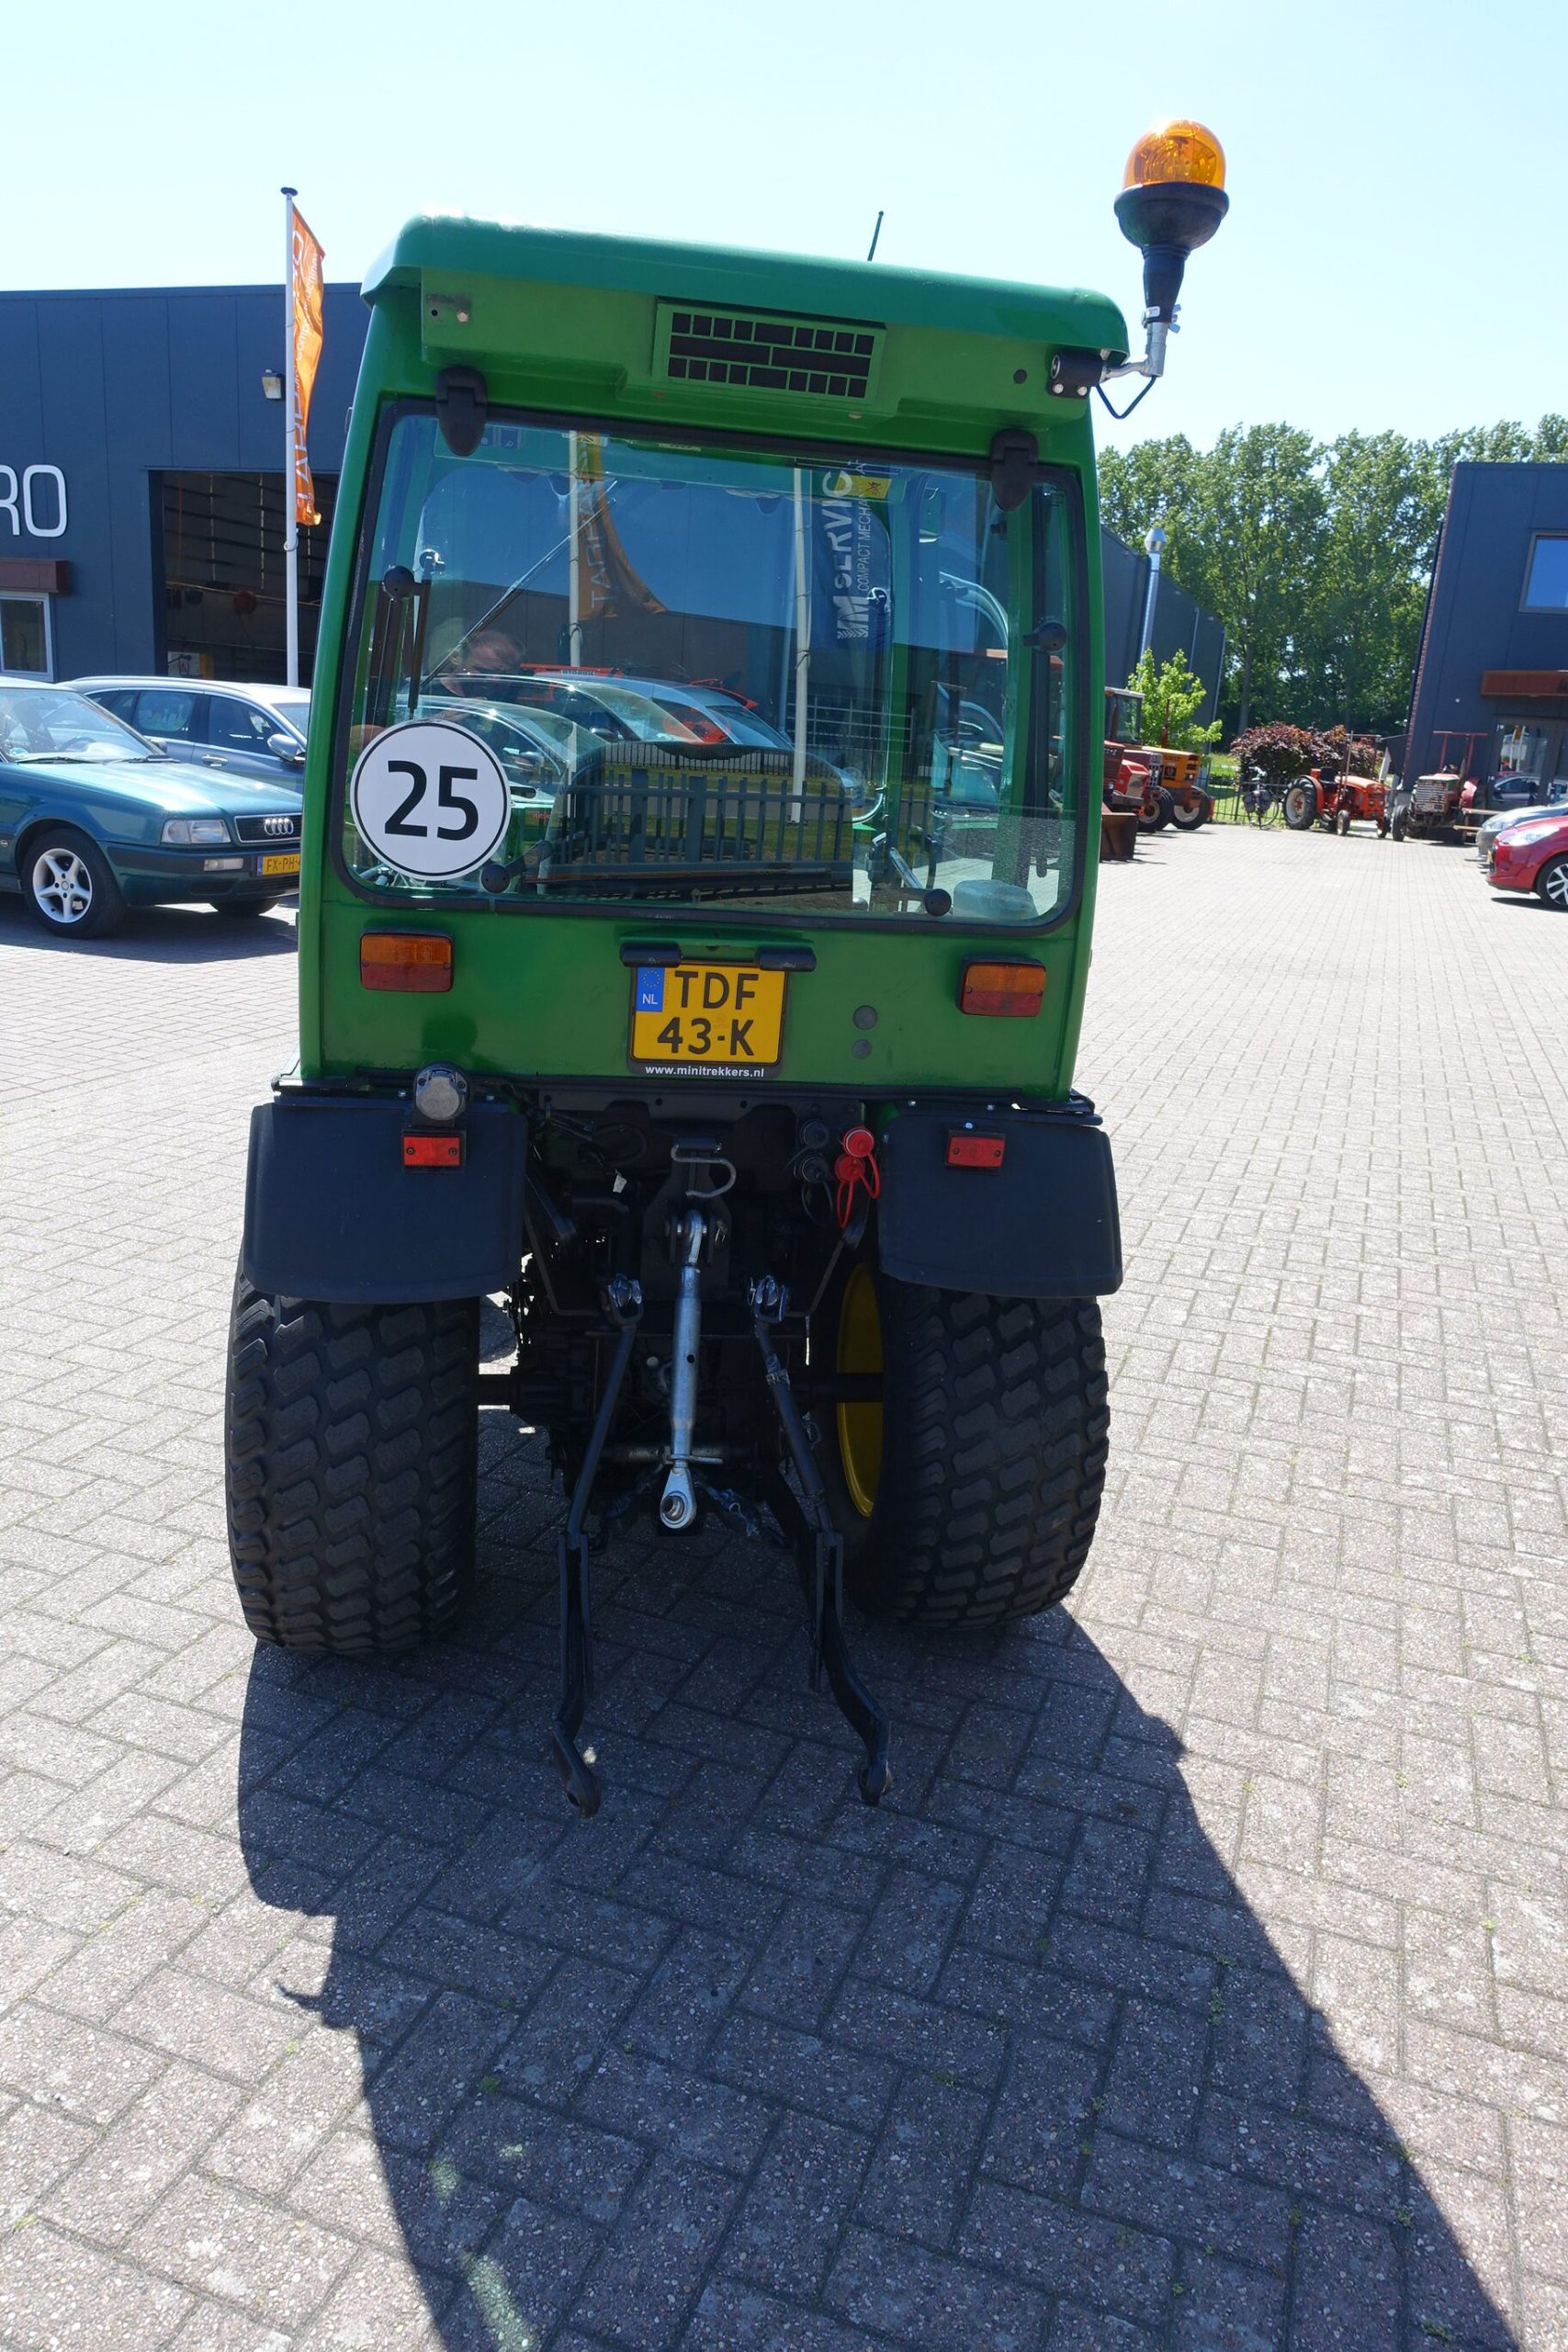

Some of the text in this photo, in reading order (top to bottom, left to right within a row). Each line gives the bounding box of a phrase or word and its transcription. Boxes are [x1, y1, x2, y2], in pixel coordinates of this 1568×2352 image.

[857, 540, 870, 592] COMPACT
[384, 760, 479, 841] 25
[641, 993, 659, 1005] NL
[674, 970, 760, 1011] TDF
[657, 1016, 755, 1057] 43-K
[645, 1065, 764, 1078] www.minitrekkers.nl
